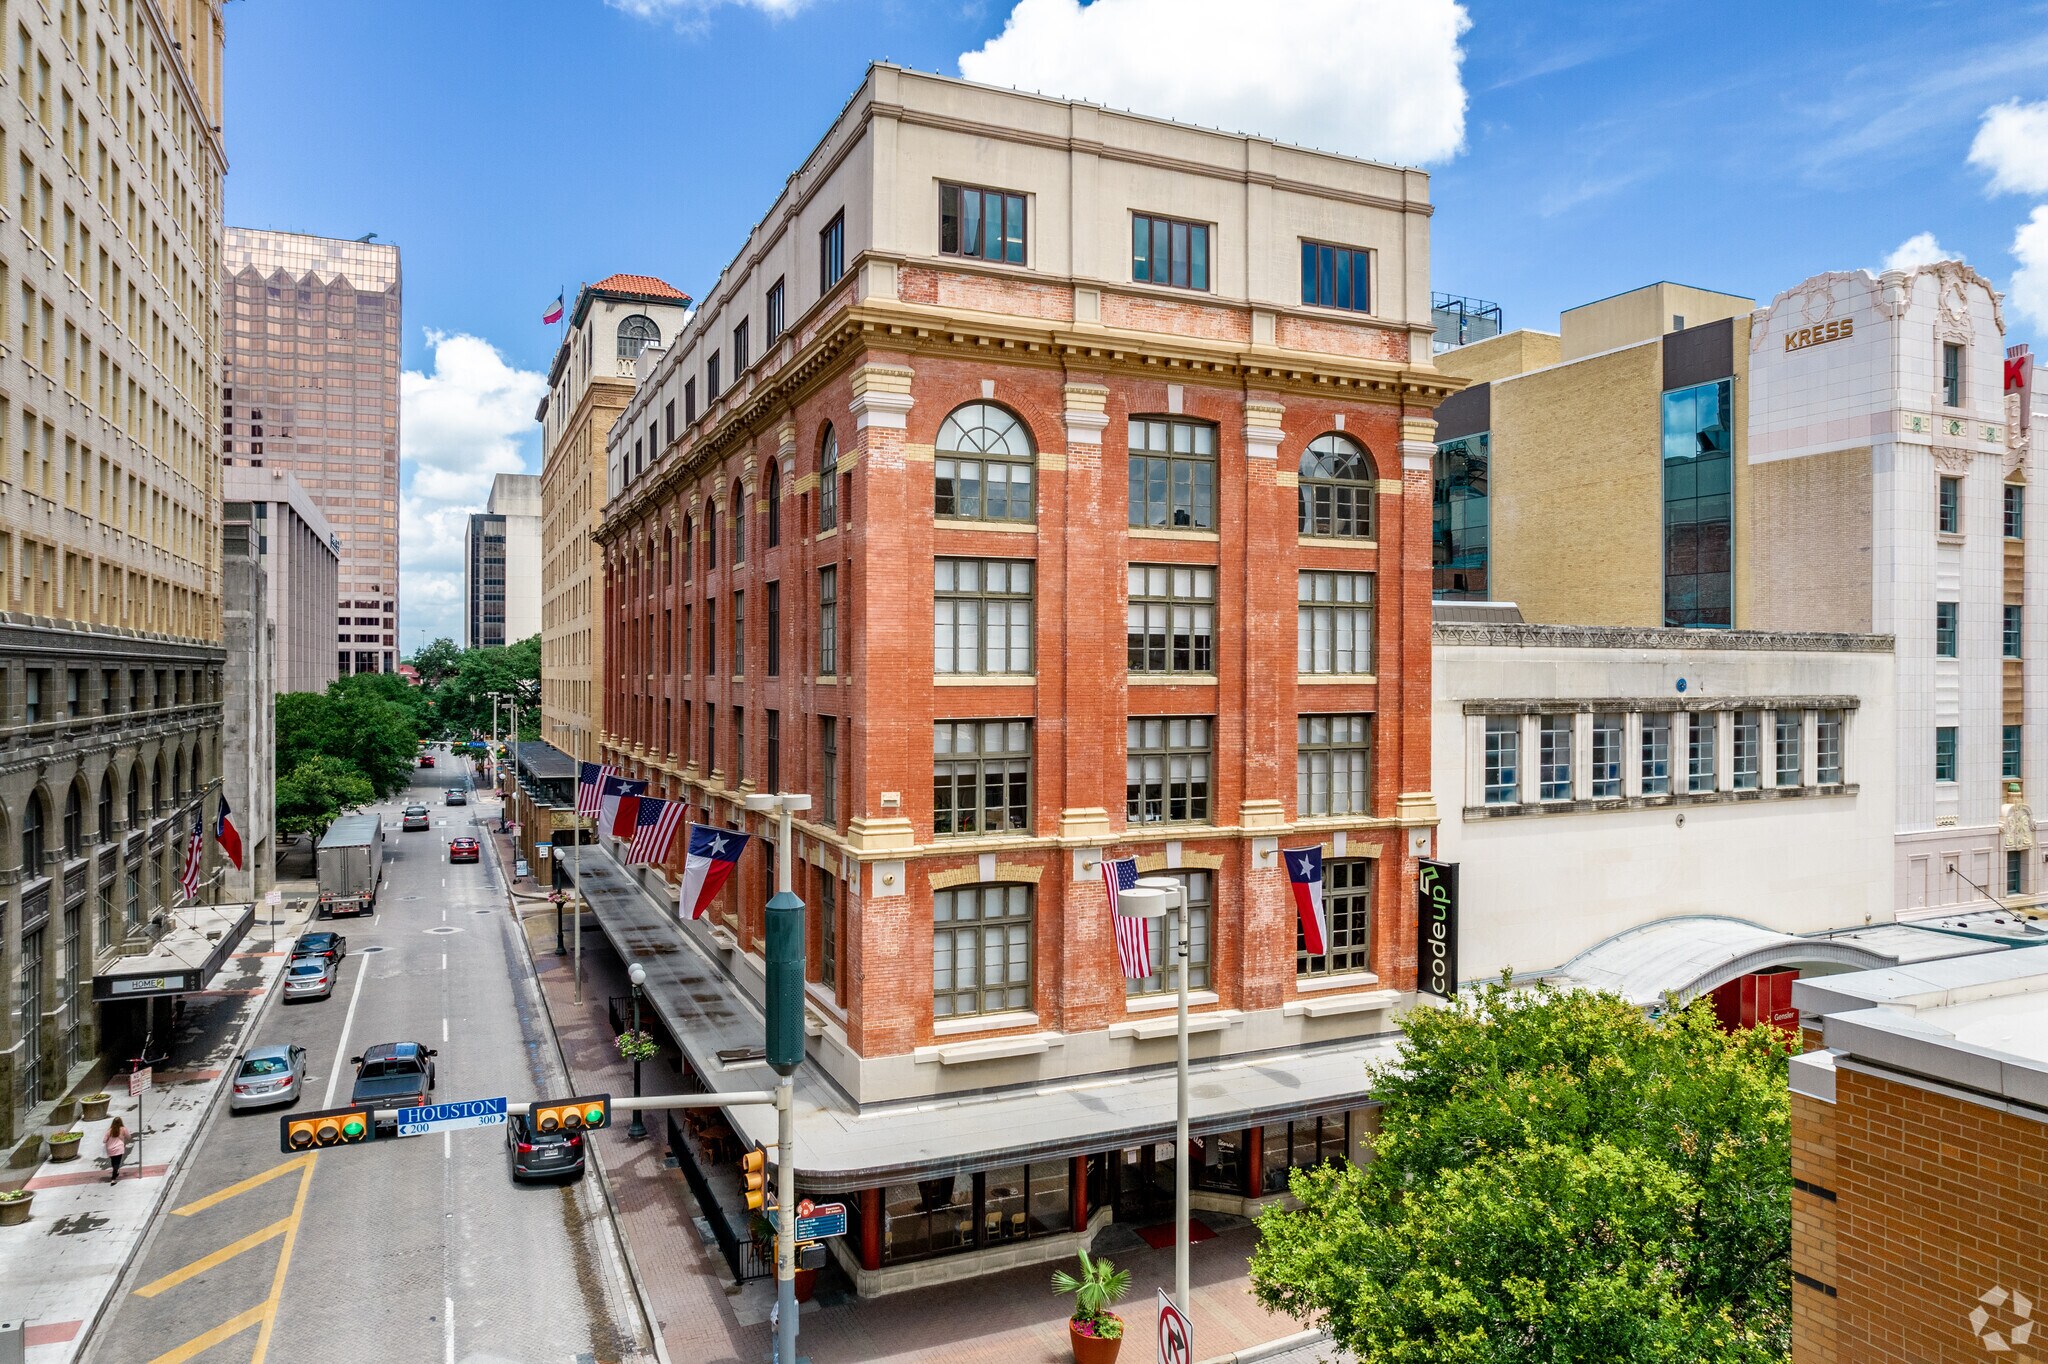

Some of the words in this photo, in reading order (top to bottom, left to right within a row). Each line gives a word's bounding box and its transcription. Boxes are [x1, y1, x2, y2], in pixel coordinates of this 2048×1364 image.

[1785, 318, 1854, 351] KRESS
[2004, 357, 2025, 390] K
[1427, 885, 1451, 994] codeup
[1774, 1011, 1795, 1021] Gensler
[408, 1099, 498, 1123] HOUSTON
[411, 1123, 429, 1134] 200
[478, 1115, 496, 1126] 300
